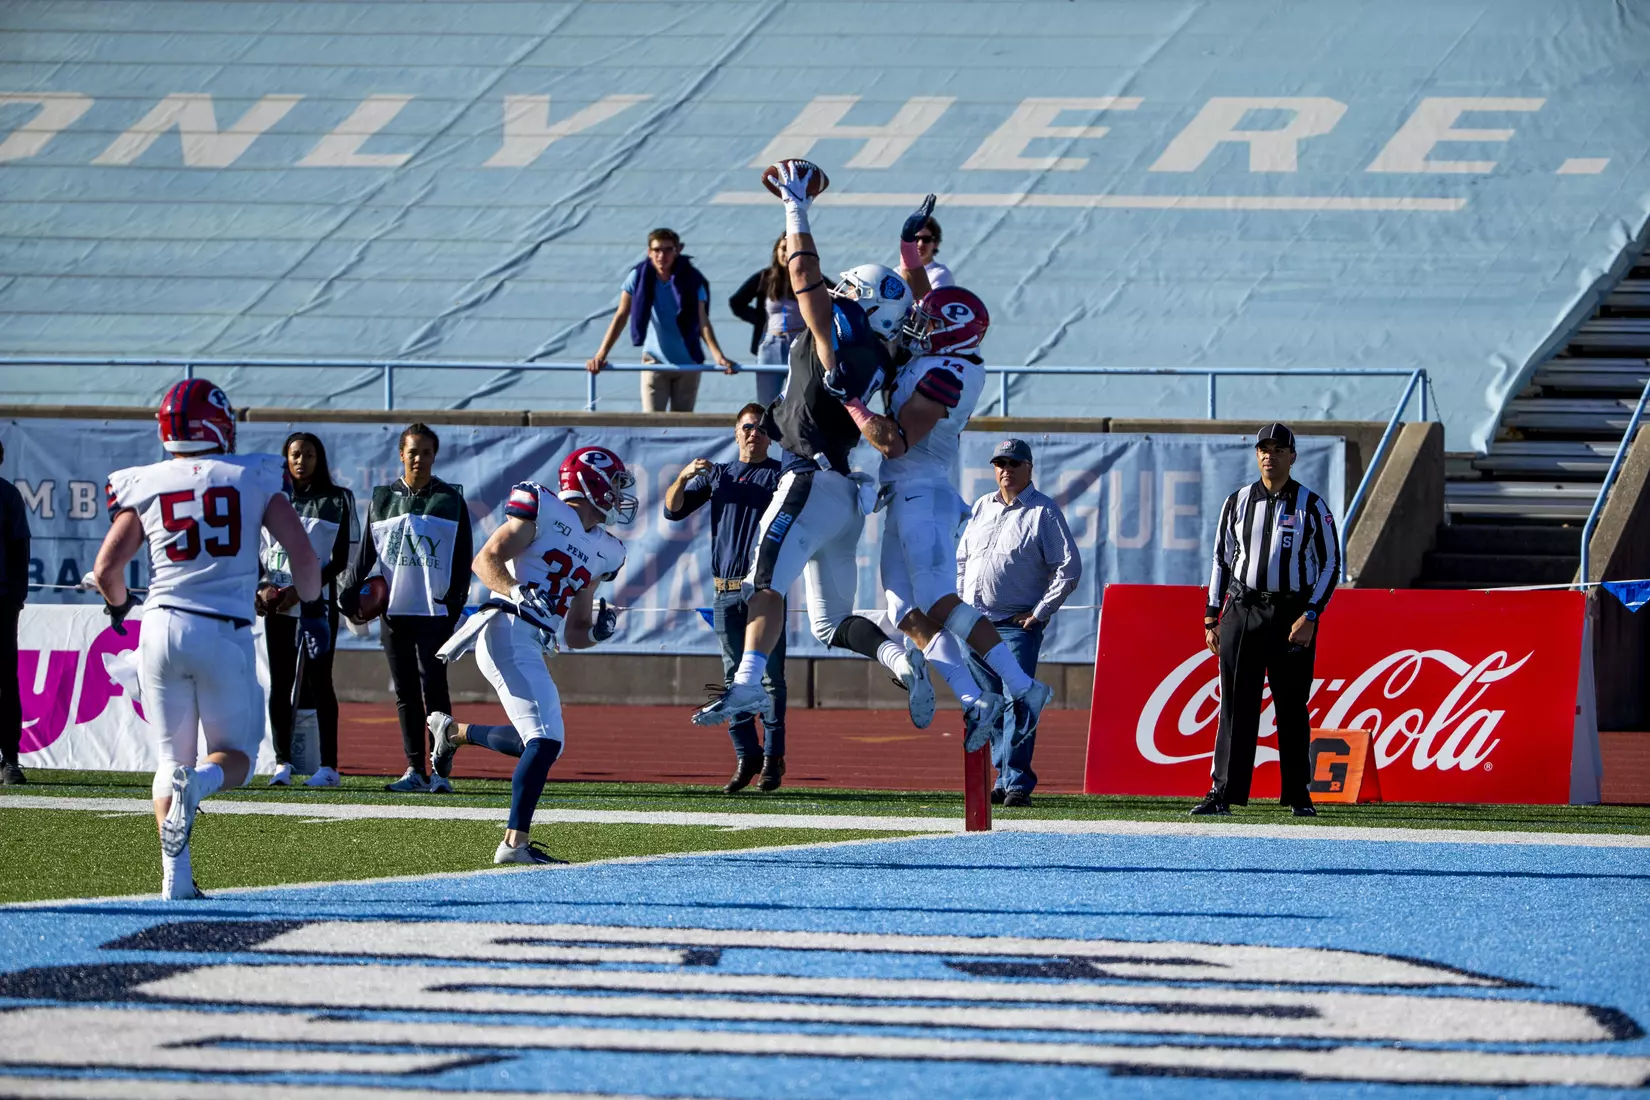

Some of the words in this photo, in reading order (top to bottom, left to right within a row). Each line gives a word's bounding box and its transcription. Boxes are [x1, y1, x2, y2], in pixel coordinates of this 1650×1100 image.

[749, 96, 1611, 175] HERE.
[946, 304, 970, 321] P
[942, 359, 965, 374] 14
[584, 451, 608, 466] P
[159, 485, 242, 562] 59
[553, 519, 572, 537] 150
[766, 511, 793, 543] LIONS
[566, 543, 590, 564] PENN
[1282, 535, 1293, 548] S
[527, 547, 592, 619] 32
[1136, 649, 1535, 771] Co-Cola
[1309, 737, 1351, 793] G
